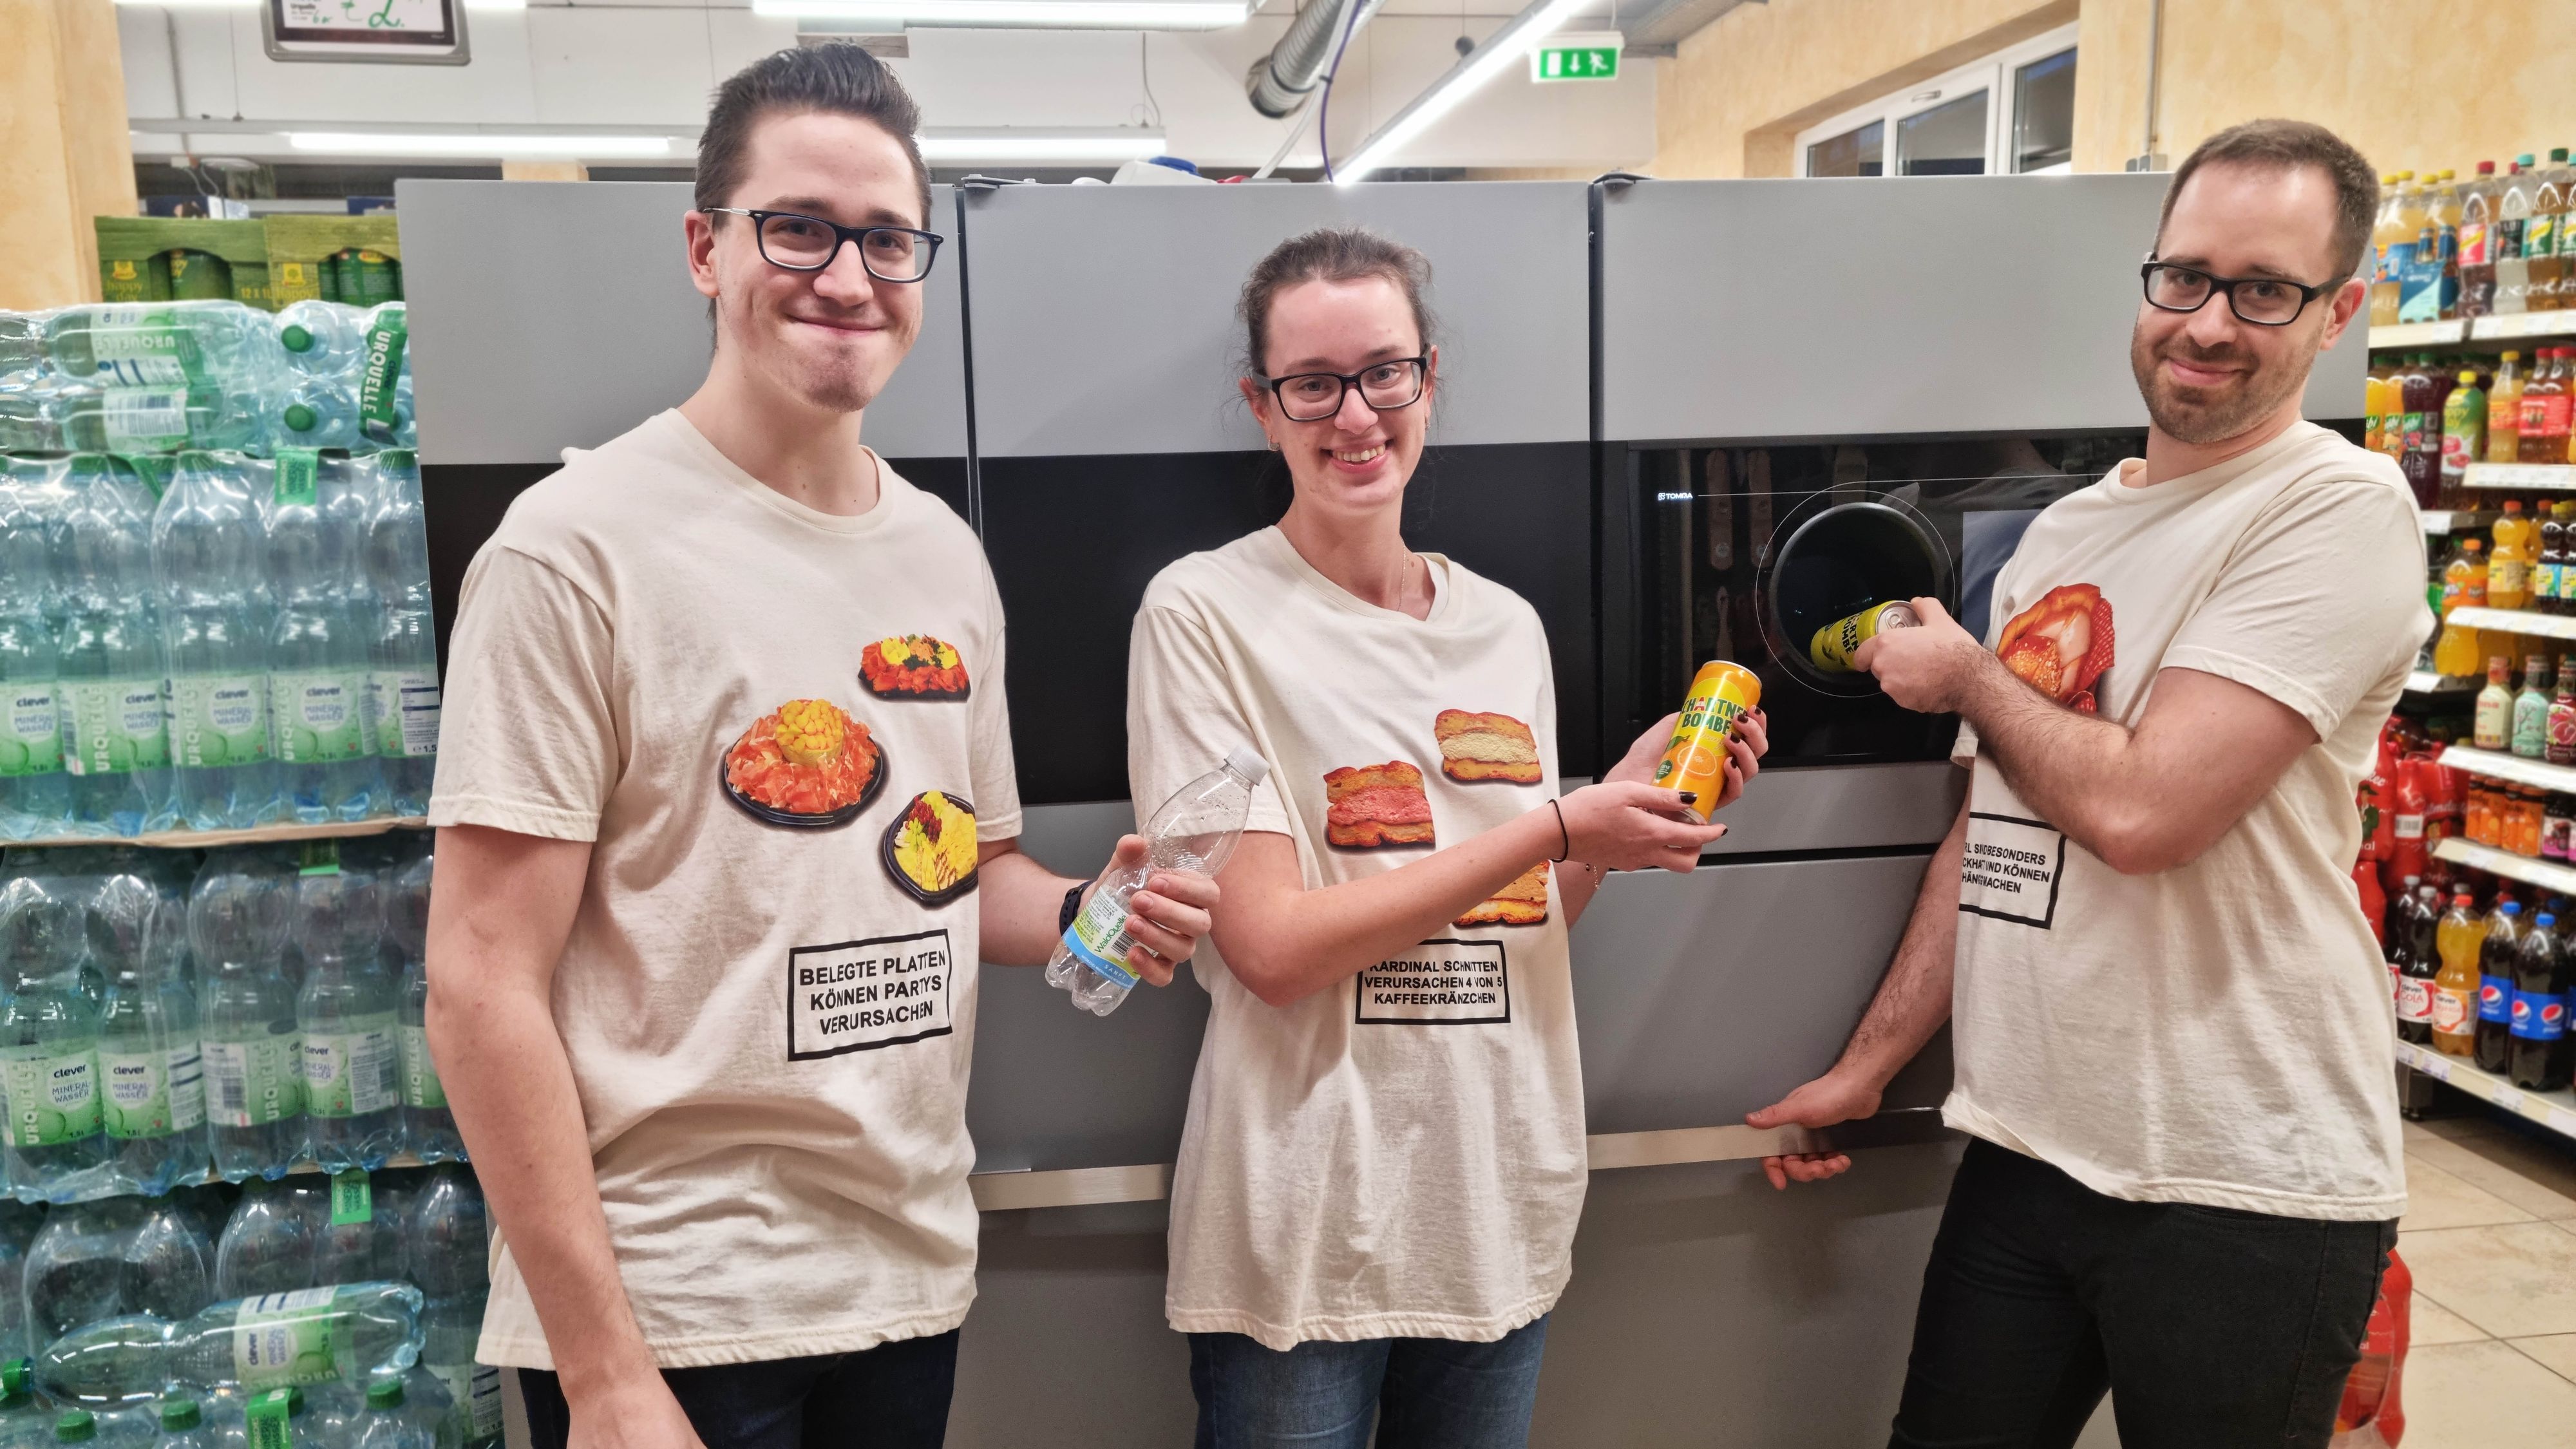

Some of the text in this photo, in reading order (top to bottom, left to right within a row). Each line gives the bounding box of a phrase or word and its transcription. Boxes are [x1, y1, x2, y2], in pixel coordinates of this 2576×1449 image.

[363, 330, 392, 413] URQUELLE
[16, 697, 50, 707] clever
[1682, 713, 1732, 735] BOMBE
[1987, 845, 2046, 865] BESONDERS
[2003, 864, 2050, 883] KÖNNEN
[800, 950, 945, 986] BELEGTE PLATTEN
[1104, 964, 1127, 980] SANFT
[1443, 960, 1499, 972] SCHNITTEN
[1365, 976, 1502, 988] VERURSACHEN 4 VON 5
[810, 974, 942, 1010] KÖNNEN PARTYS
[1374, 990, 1496, 1005] KAFFEEKRÄNZCHEN
[820, 1000, 933, 1035] VERURSACHEN
[305, 1046, 329, 1056] clever
[53, 1064, 86, 1079] clever
[113, 1066, 146, 1075] clever
[54, 1090, 90, 1104] WASSER
[115, 1090, 149, 1100] WASSER
